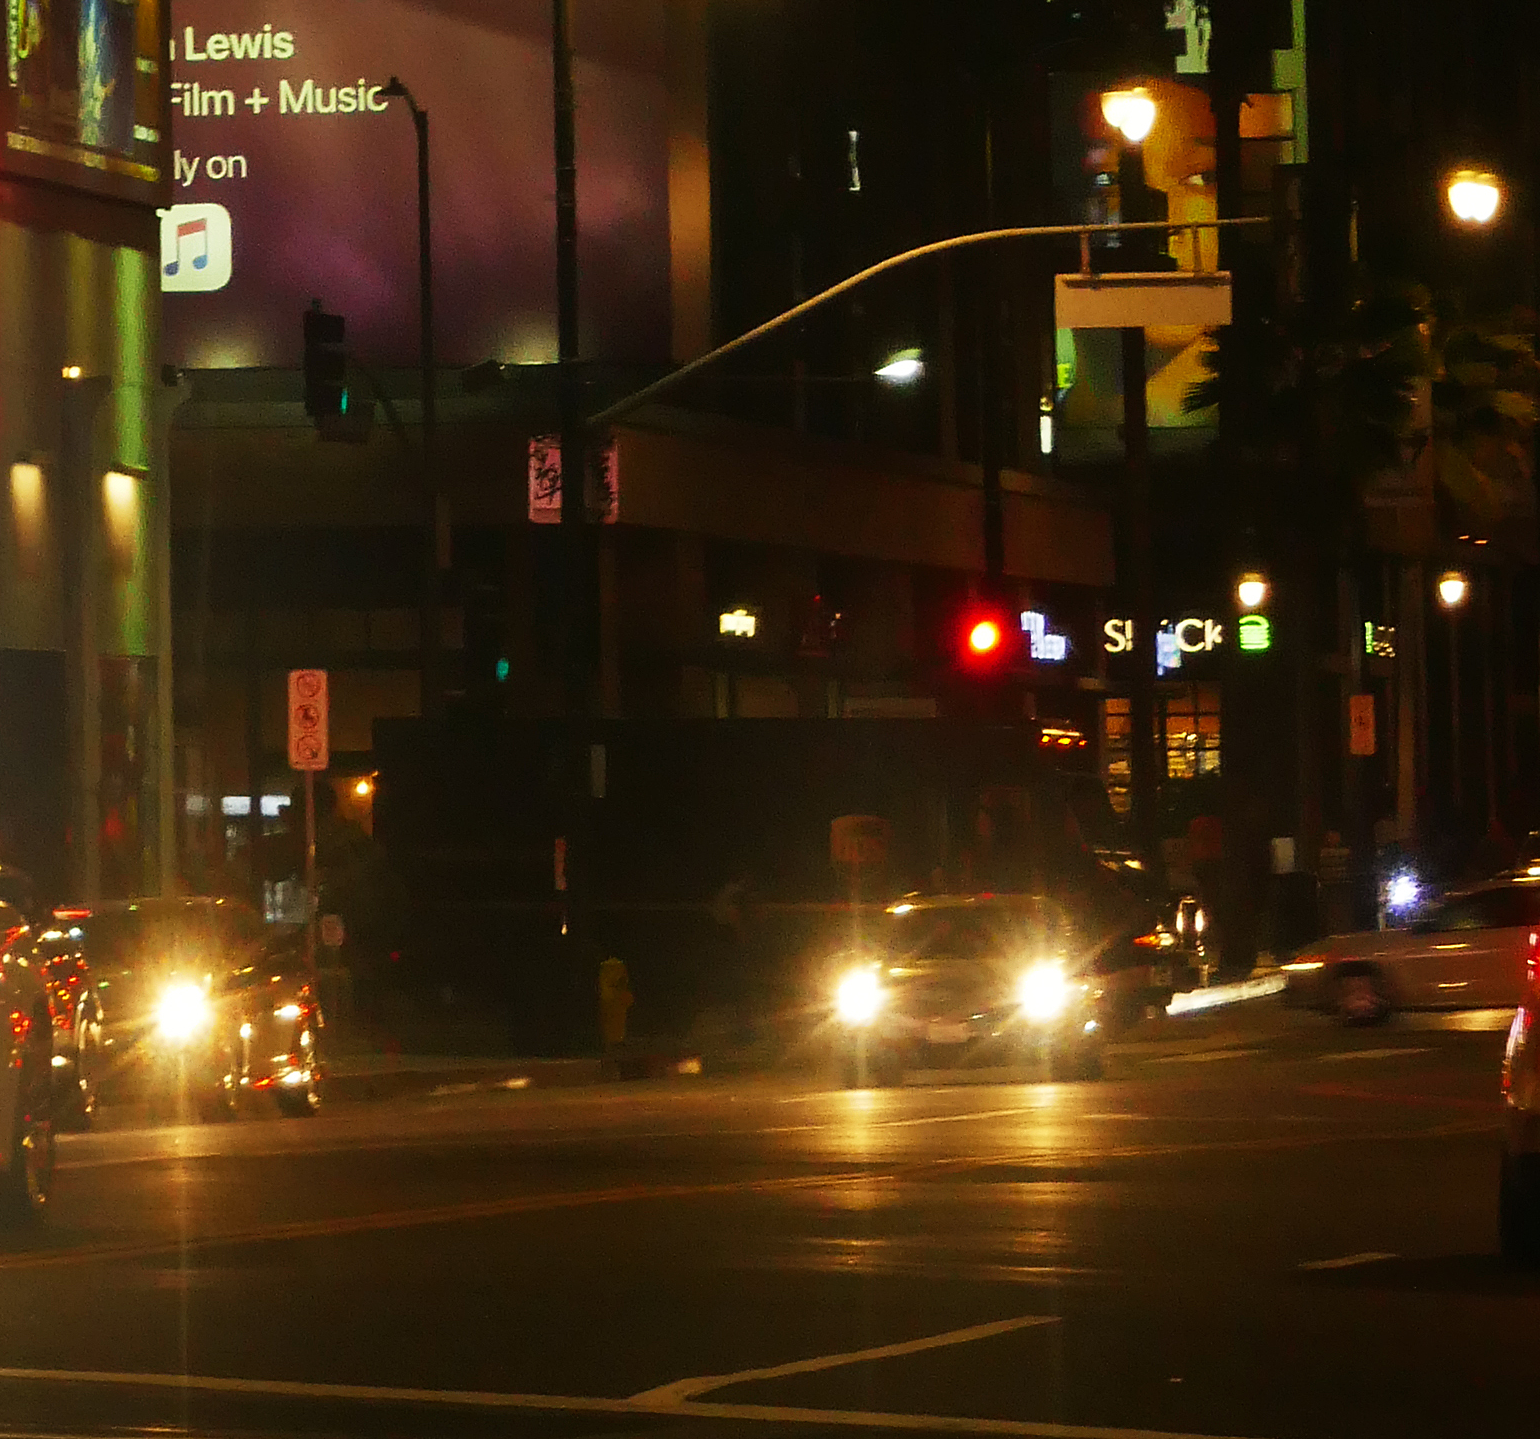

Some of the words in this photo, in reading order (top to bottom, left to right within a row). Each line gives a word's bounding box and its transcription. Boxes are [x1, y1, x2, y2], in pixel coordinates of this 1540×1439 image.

[184, 23, 295, 62] Lewis
[278, 77, 390, 115] Music
[205, 153, 248, 180] on
